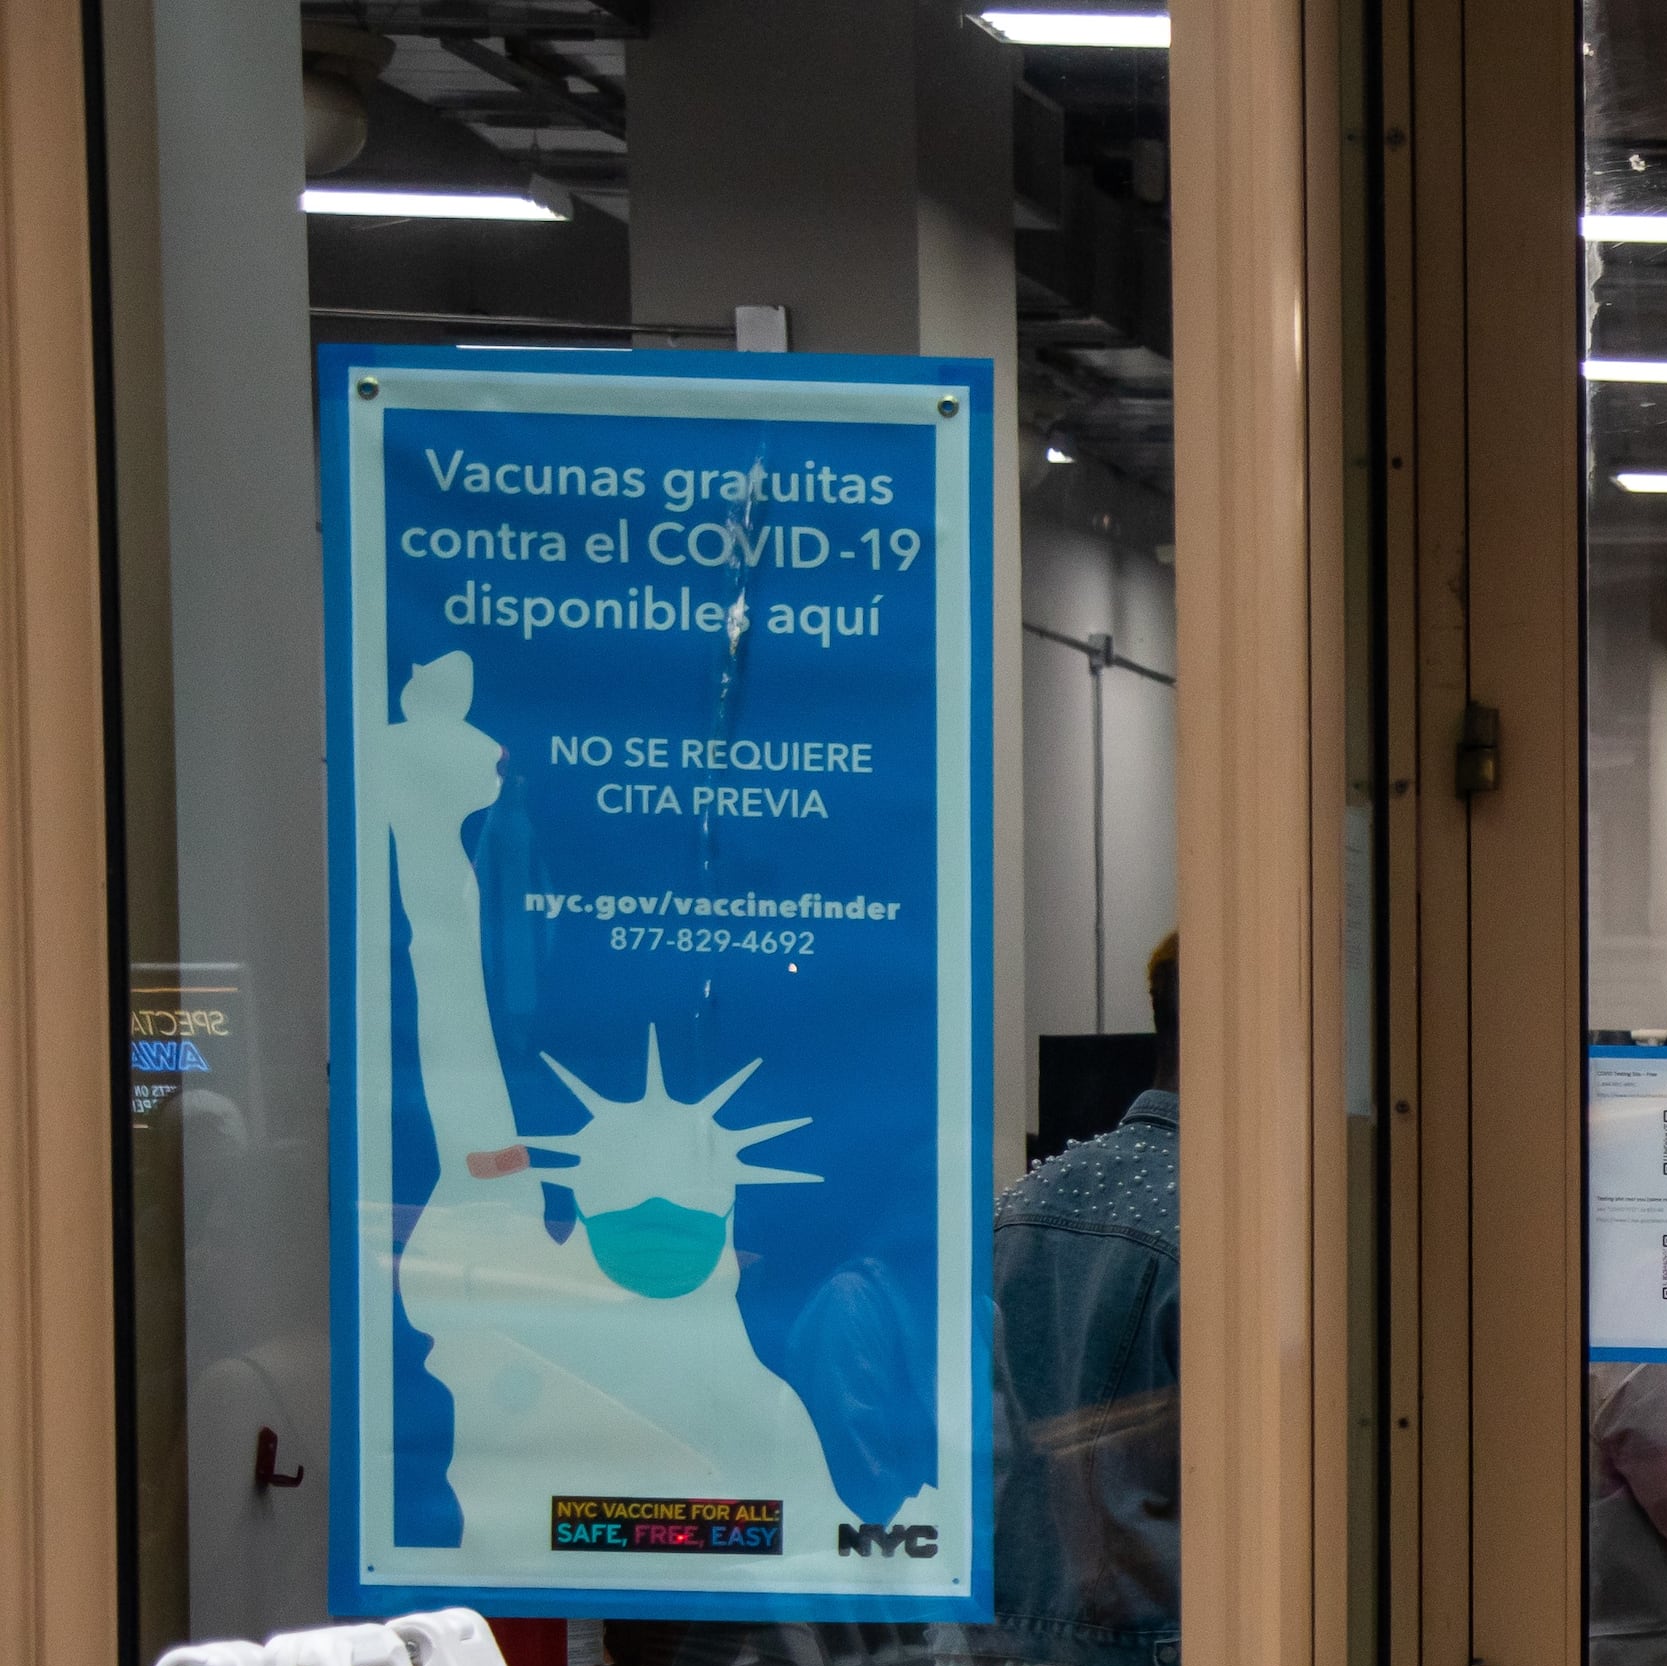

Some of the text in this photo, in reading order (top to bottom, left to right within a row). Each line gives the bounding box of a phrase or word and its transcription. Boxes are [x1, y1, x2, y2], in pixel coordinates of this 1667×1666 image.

[424, 447, 895, 512] Vacunas gratuitas
[401, 519, 922, 572] contra el COVID-19
[444, 581, 881, 648] disponibles aquí
[550, 735, 874, 774] NO SE REQUIERE
[596, 784, 829, 819] CITA PREVIA
[524, 891, 901, 922] nyc.gov/vaccinefinder
[609, 926, 816, 955] 877-829-4692
[557, 1502, 598, 1519] NYC
[602, 1503, 686, 1520] VACCINE
[693, 1504, 732, 1521] FOR
[557, 1524, 628, 1548] SAFE,
[711, 1526, 778, 1548] EASY
[838, 1523, 939, 1558] NYC
